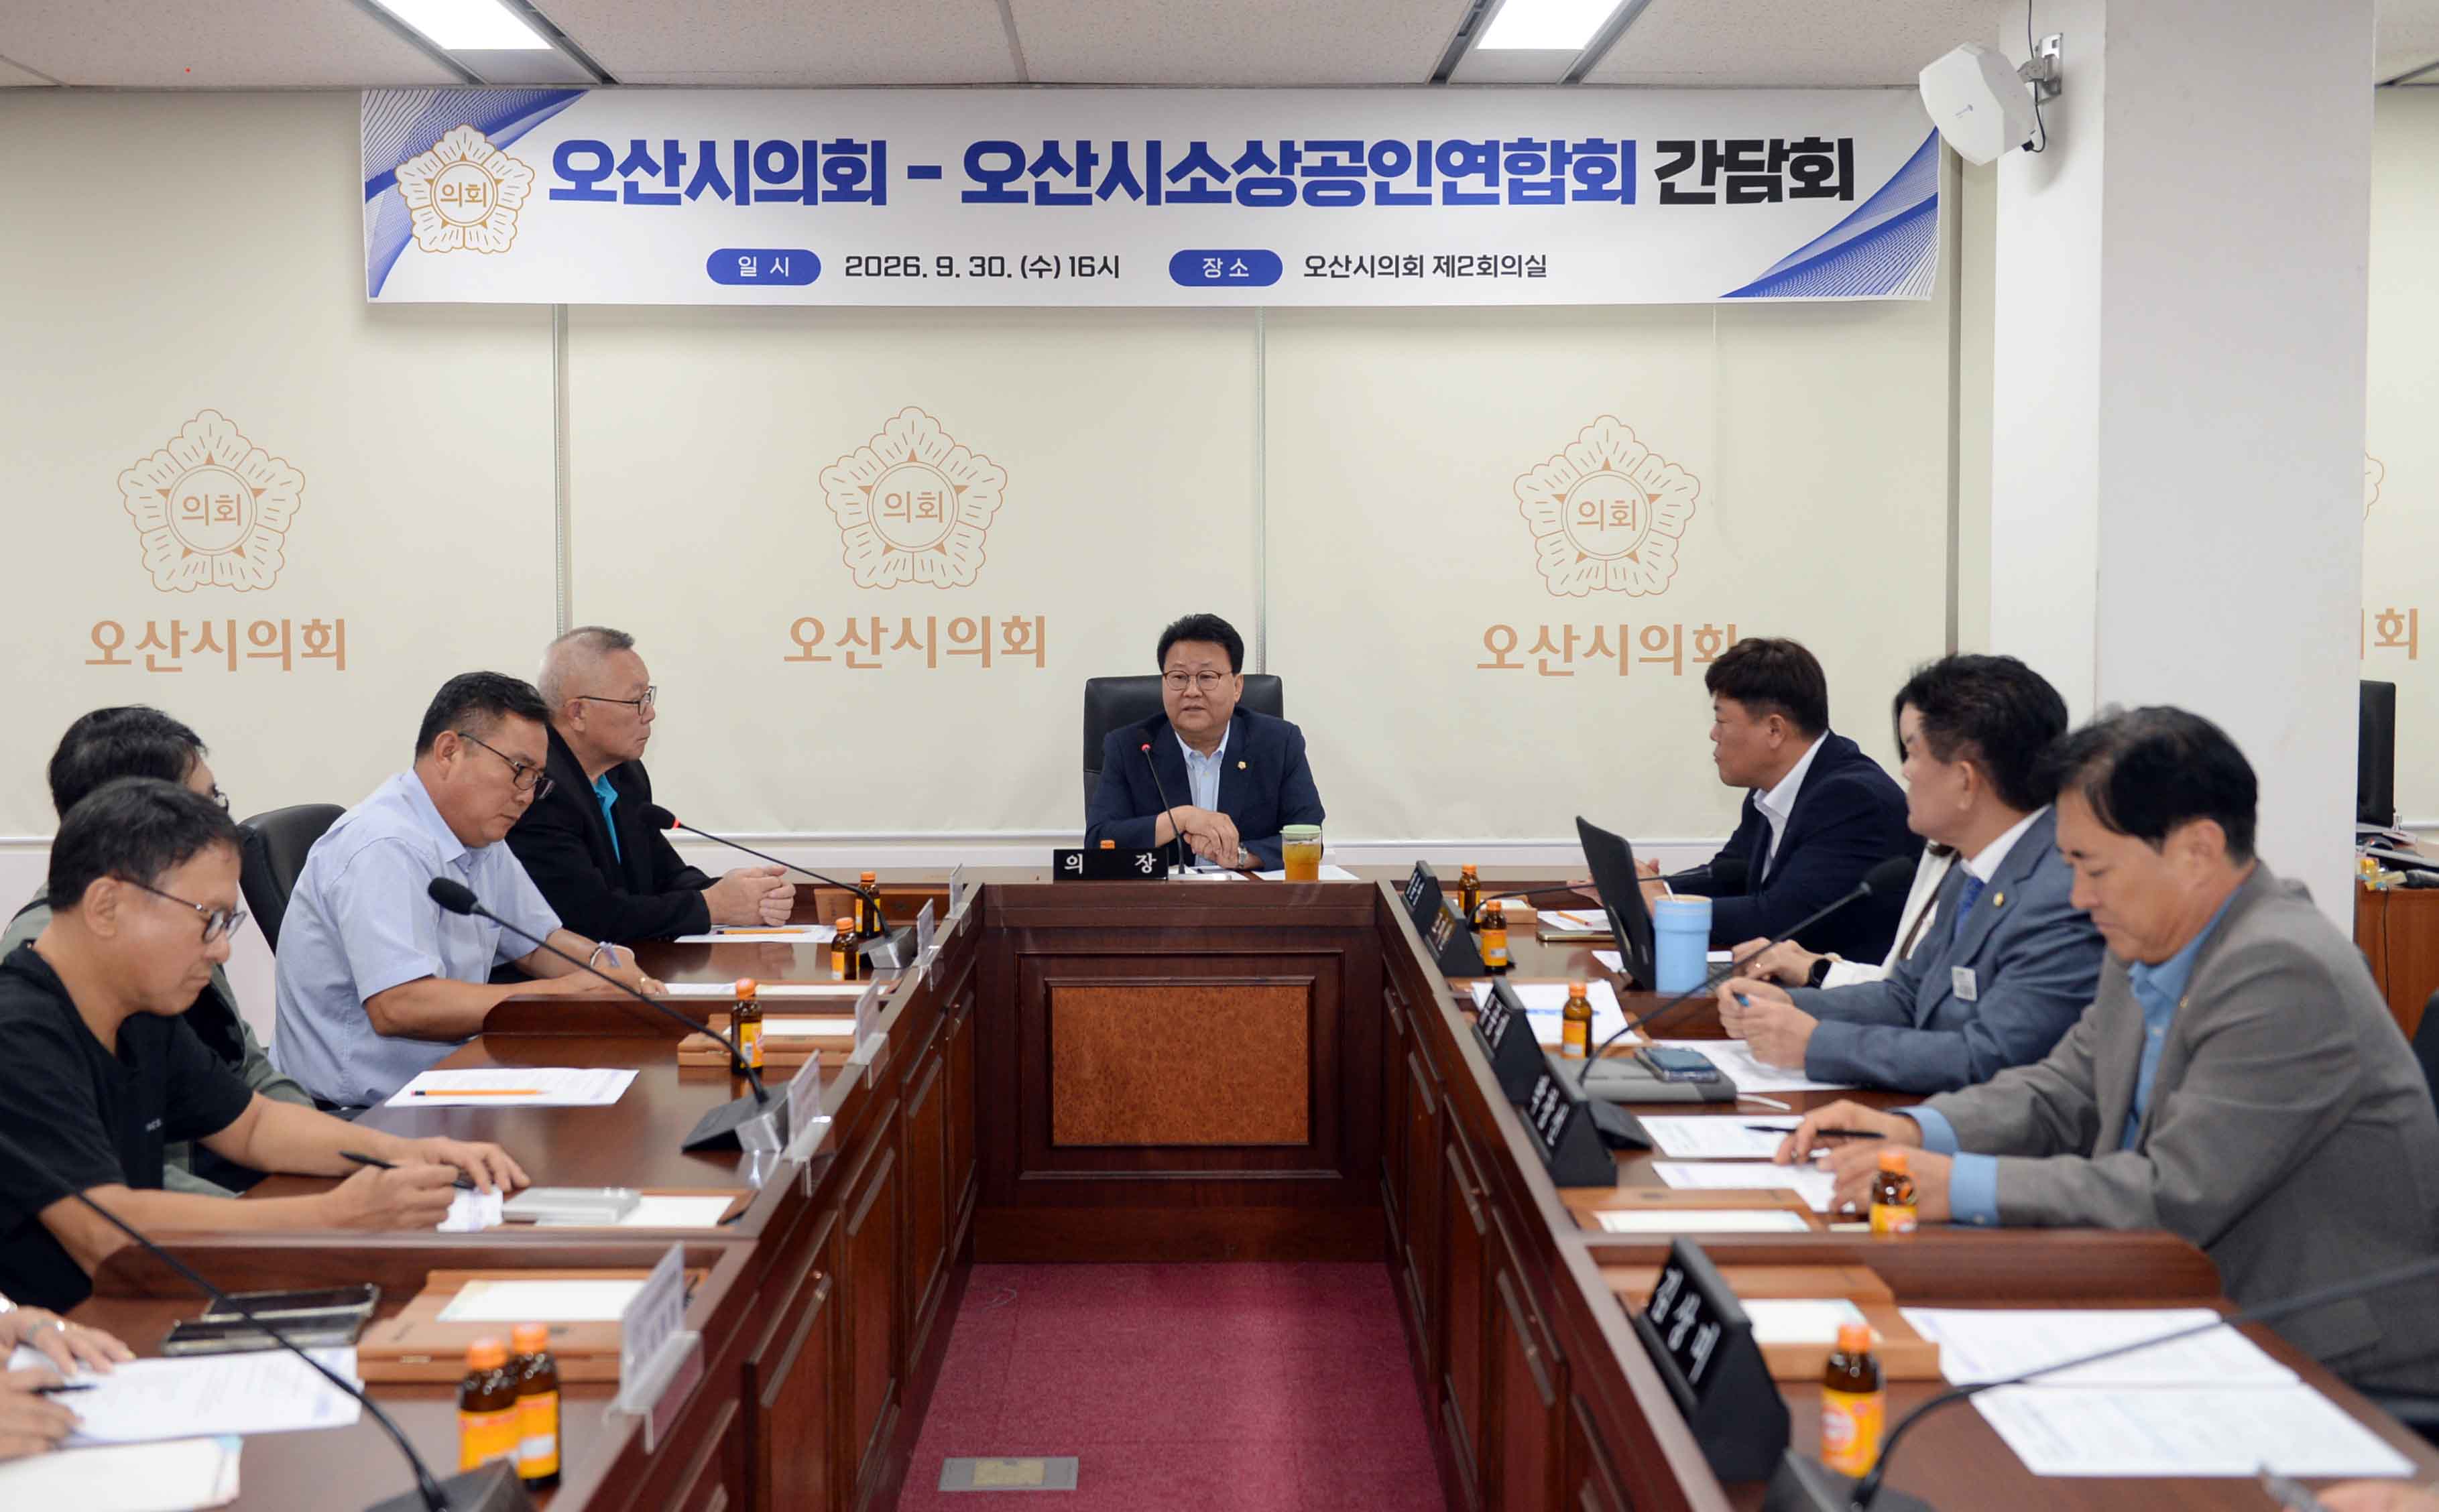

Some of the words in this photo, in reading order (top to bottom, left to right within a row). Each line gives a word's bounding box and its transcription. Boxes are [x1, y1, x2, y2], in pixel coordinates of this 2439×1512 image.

[549, 137, 888, 206] 오산시의회
[961, 137, 1637, 207] 오산시소상공인연합회
[1654, 136, 1856, 204] 간담회
[439, 182, 489, 209] 의회
[845, 255, 928, 278] 2026.
[936, 255, 961, 278] 9.
[969, 255, 1013, 278] 30.
[1304, 255, 1424, 279] 오산시의회
[1432, 255, 1548, 279] 제2회의실
[182, 493, 242, 526] 의회
[883, 491, 944, 523] 의회
[1576, 499, 1637, 531] 의회
[84, 617, 347, 672] 오산시의회
[783, 615, 1045, 669] 오산시의회
[1476, 623, 1737, 676] 오산시의회
